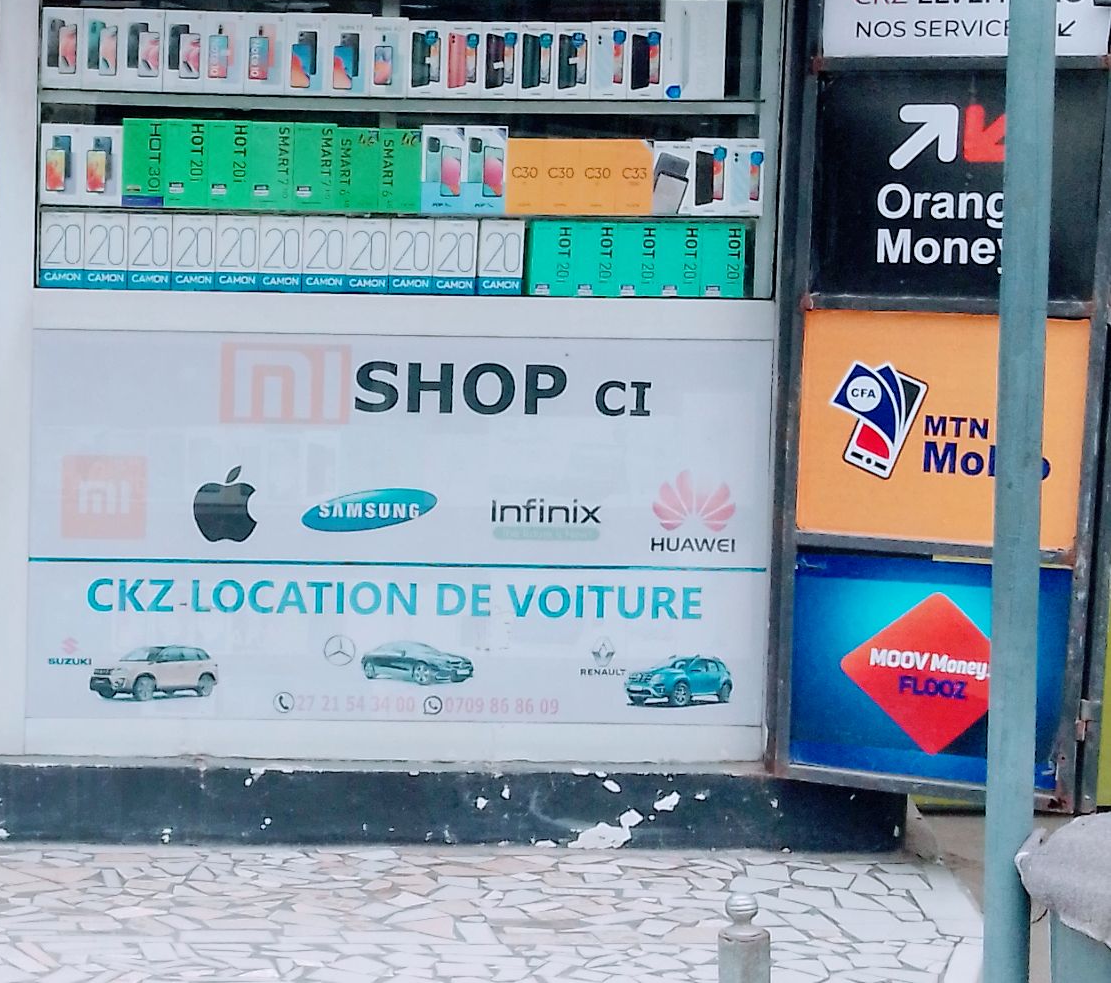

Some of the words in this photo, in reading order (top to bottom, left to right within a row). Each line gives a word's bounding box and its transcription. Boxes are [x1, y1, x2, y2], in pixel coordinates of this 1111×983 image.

[856, 20, 907, 38] NOS
[149, 123, 162, 164] HOT
[190, 123, 204, 156] HOT
[234, 125, 248, 158] HOT
[278, 127, 289, 175] SMART
[321, 128, 333, 176] SMART
[189, 159, 203, 182] 20i
[233, 161, 247, 183] 20i
[339, 139, 352, 186] SMART
[382, 140, 394, 186] SMART
[512, 167, 538, 179] C30
[548, 168, 574, 179] C30
[584, 167, 611, 179] C30
[622, 167, 647, 179] C33
[876, 182, 1004, 229] Orang
[44, 224, 81, 264] 20
[89, 225, 124, 265] 20
[132, 226, 169, 266] 20
[176, 227, 212, 267] 20
[220, 227, 256, 267] 20
[263, 228, 300, 269] 20
[306, 228, 344, 269] 20
[350, 230, 386, 271] 20
[393, 231, 430, 271] 20
[438, 232, 474, 272] 20
[484, 233, 521, 272] 20
[558, 227, 572, 258] HOT
[600, 227, 614, 258] HOT
[643, 227, 656, 259] HOT
[685, 228, 699, 259] HOT
[728, 228, 742, 259] HOT
[875, 228, 1004, 274] Mone
[44, 272, 81, 282] CAMON
[88, 272, 124, 282] CAMON
[131, 274, 168, 284] CAMON
[175, 275, 212, 285] CAMON
[219, 275, 255, 285] CAMON
[263, 276, 299, 286] CAMON
[306, 277, 343, 287] CAMON
[349, 278, 386, 288] CAMON
[392, 278, 429, 289] CAMON
[436, 279, 473, 289] CAMON
[482, 279, 520, 290] CAMON
[354, 360, 568, 416] SHOP
[595, 380, 652, 417] CI
[851, 388, 876, 399] CFA
[924, 415, 990, 440] MTN
[318, 502, 421, 520] SAMSUNG
[650, 537, 736, 554] HUAWEI
[439, 583, 491, 617] DE
[507, 583, 703, 620] VOITURE
[48, 657, 92, 666] SUZUKI
[869, 647, 931, 670] MOOV
[580, 668, 626, 677] RENAULT
[898, 675, 968, 700] FLOOZ
[297, 695, 315, 712] 27
[321, 696, 339, 713] 21
[345, 696, 365, 713] 54
[373, 696, 391, 713] 34
[445, 697, 485, 714] 0709
[490, 698, 509, 714] 86
[515, 698, 535, 715] 86
[540, 698, 560, 715] 09
